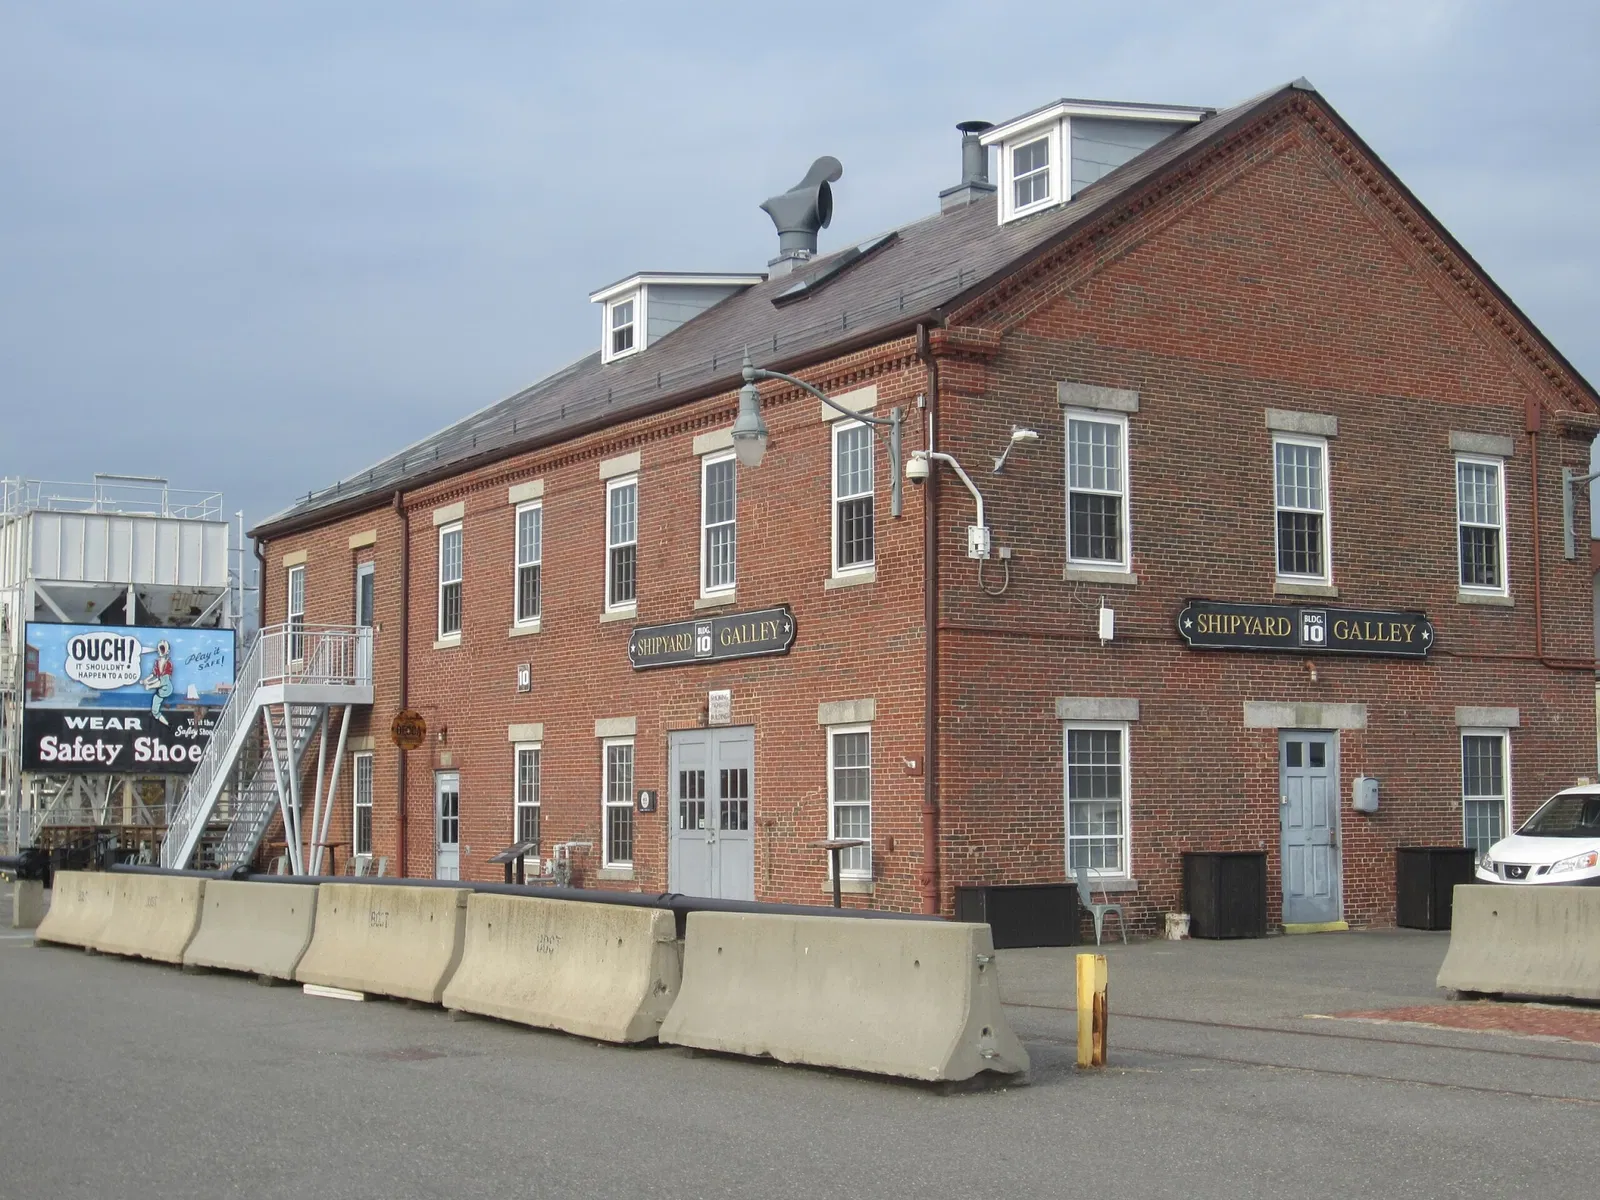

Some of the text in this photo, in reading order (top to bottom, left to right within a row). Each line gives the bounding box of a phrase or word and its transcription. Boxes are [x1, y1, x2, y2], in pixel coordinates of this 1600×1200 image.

[1304, 614, 1324, 624] BLDG.
[1197, 613, 1416, 643] SHIPYARD GALLEY
[1303, 624, 1324, 642] 10
[637, 619, 780, 656] SHIPYARD GALLEY
[696, 635, 711, 653] 10
[72, 638, 135, 669] OUCH!
[185, 652, 212, 665] Play
[78, 671, 107, 679] HAPPEN
[108, 672, 117, 680] TO
[117, 672, 123, 680] A
[519, 670, 529, 686] 10
[64, 716, 143, 730] WEAR
[187, 718, 203, 726] Viit
[39, 735, 123, 765] Safety
